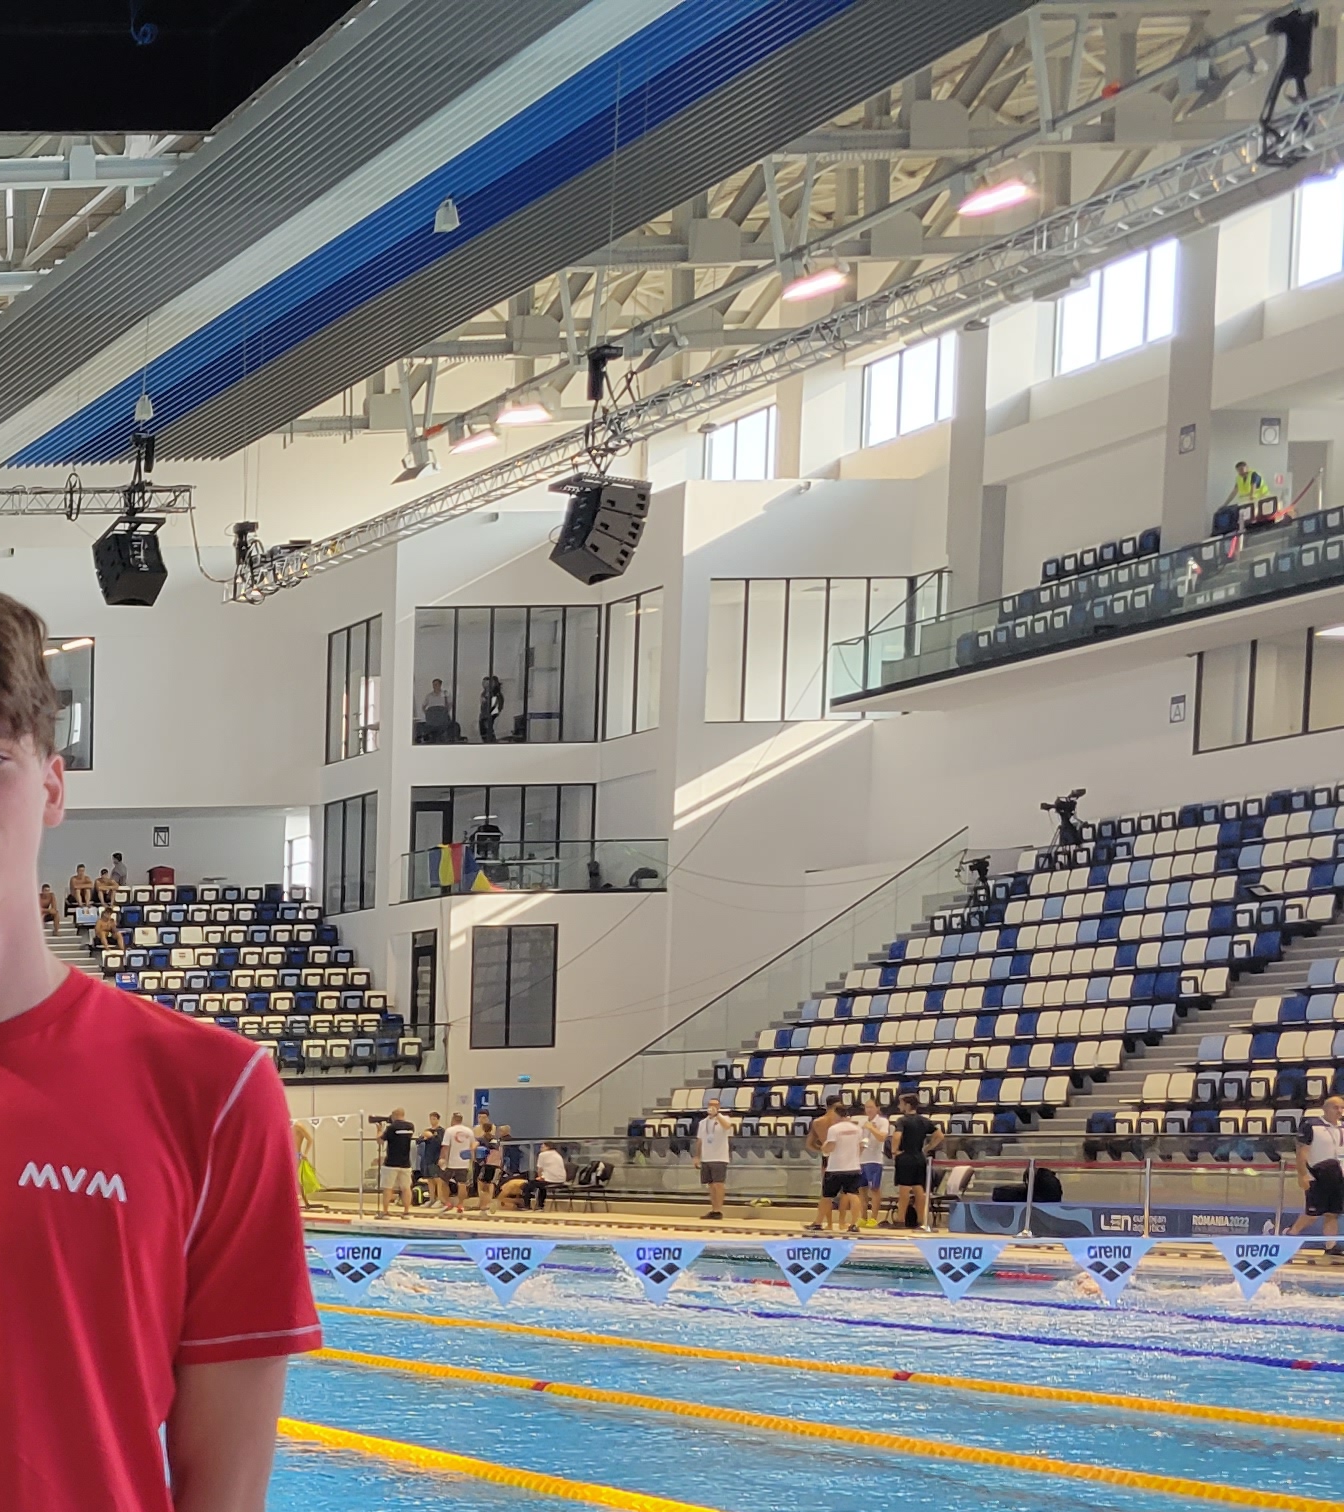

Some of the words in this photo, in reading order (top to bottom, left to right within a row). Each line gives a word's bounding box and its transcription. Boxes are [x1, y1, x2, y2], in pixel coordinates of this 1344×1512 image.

[1173, 704, 1182, 720] A
[156, 831, 167, 845] N
[18, 1161, 127, 1203] MVM
[1101, 1214, 1132, 1231] LEN
[1192, 1214, 1250, 1227] ROMANIA2022
[335, 1244, 382, 1261] arena
[485, 1245, 531, 1261] arena
[636, 1244, 682, 1261] arena
[786, 1244, 831, 1261] arena
[938, 1244, 983, 1260] arena
[1087, 1244, 1132, 1260] arena
[1235, 1243, 1280, 1258] arena
